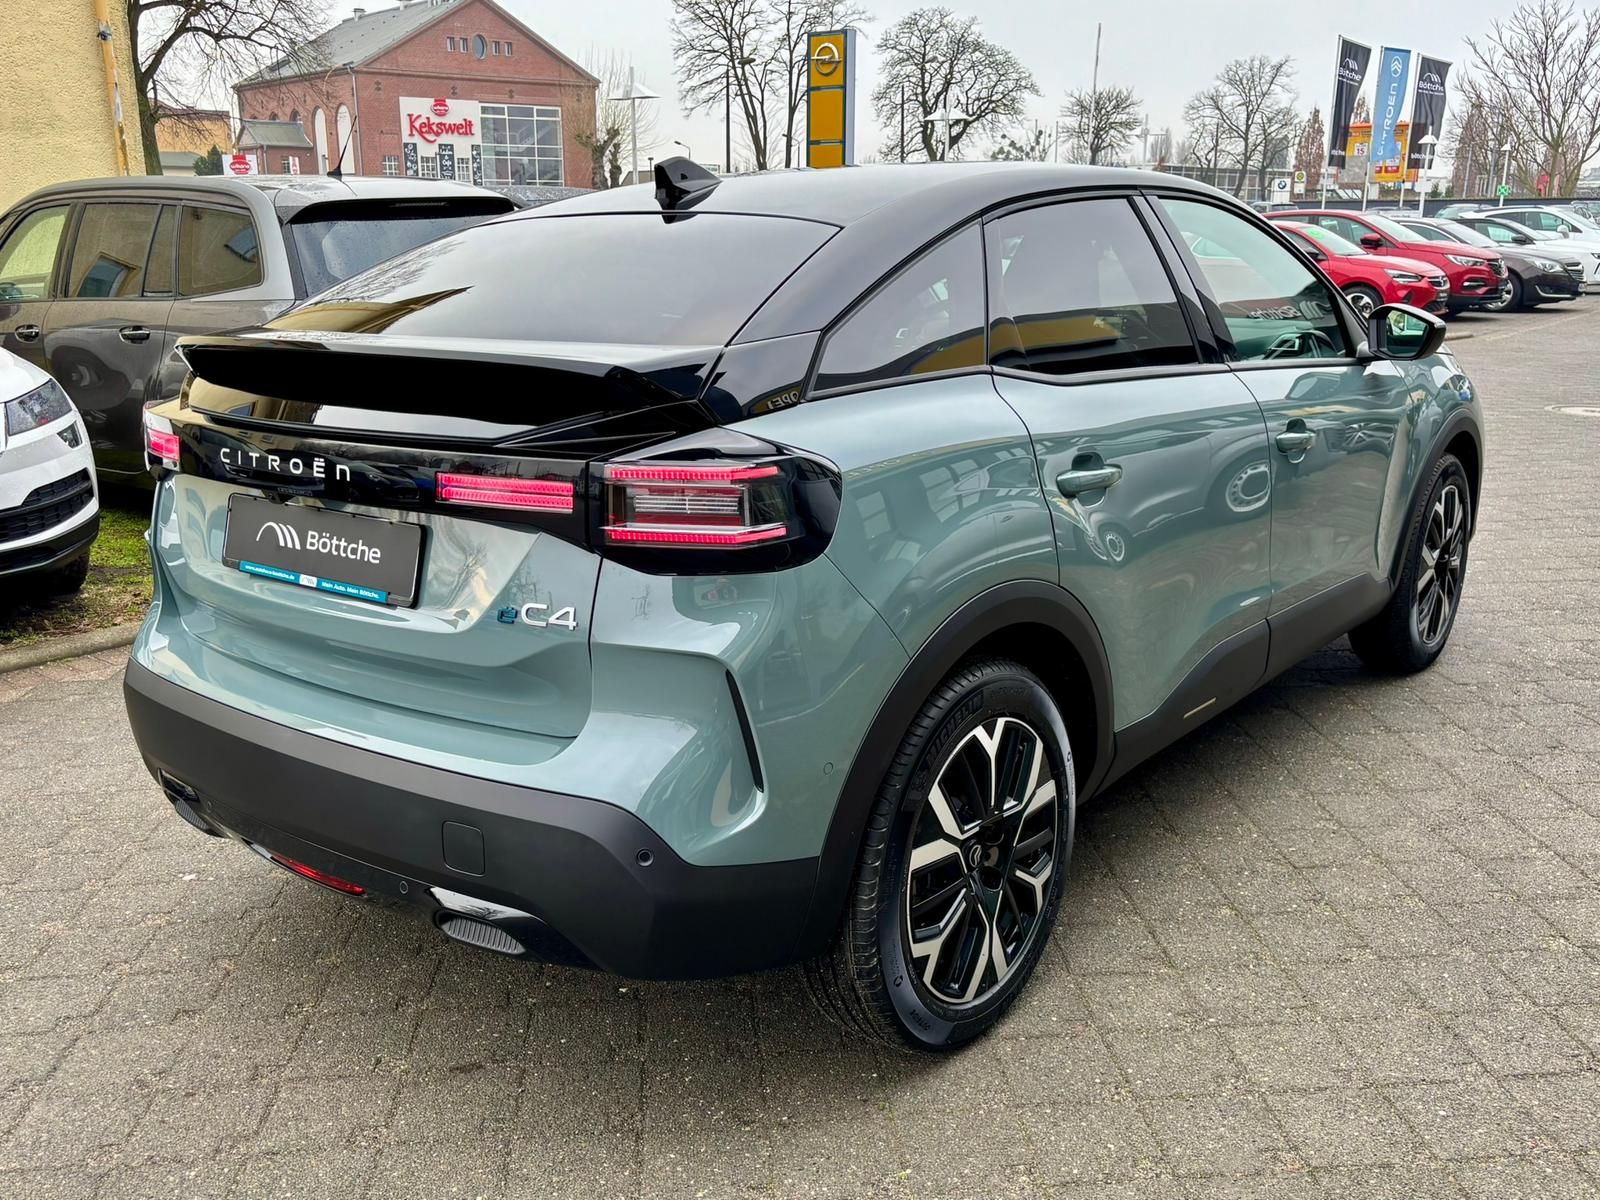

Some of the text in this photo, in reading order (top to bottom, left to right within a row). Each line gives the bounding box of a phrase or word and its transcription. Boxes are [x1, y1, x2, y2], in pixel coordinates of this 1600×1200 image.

[407, 113, 475, 144] Kekswelt
[220, 447, 350, 482] CITROËN
[305, 530, 381, 564] Böttche
